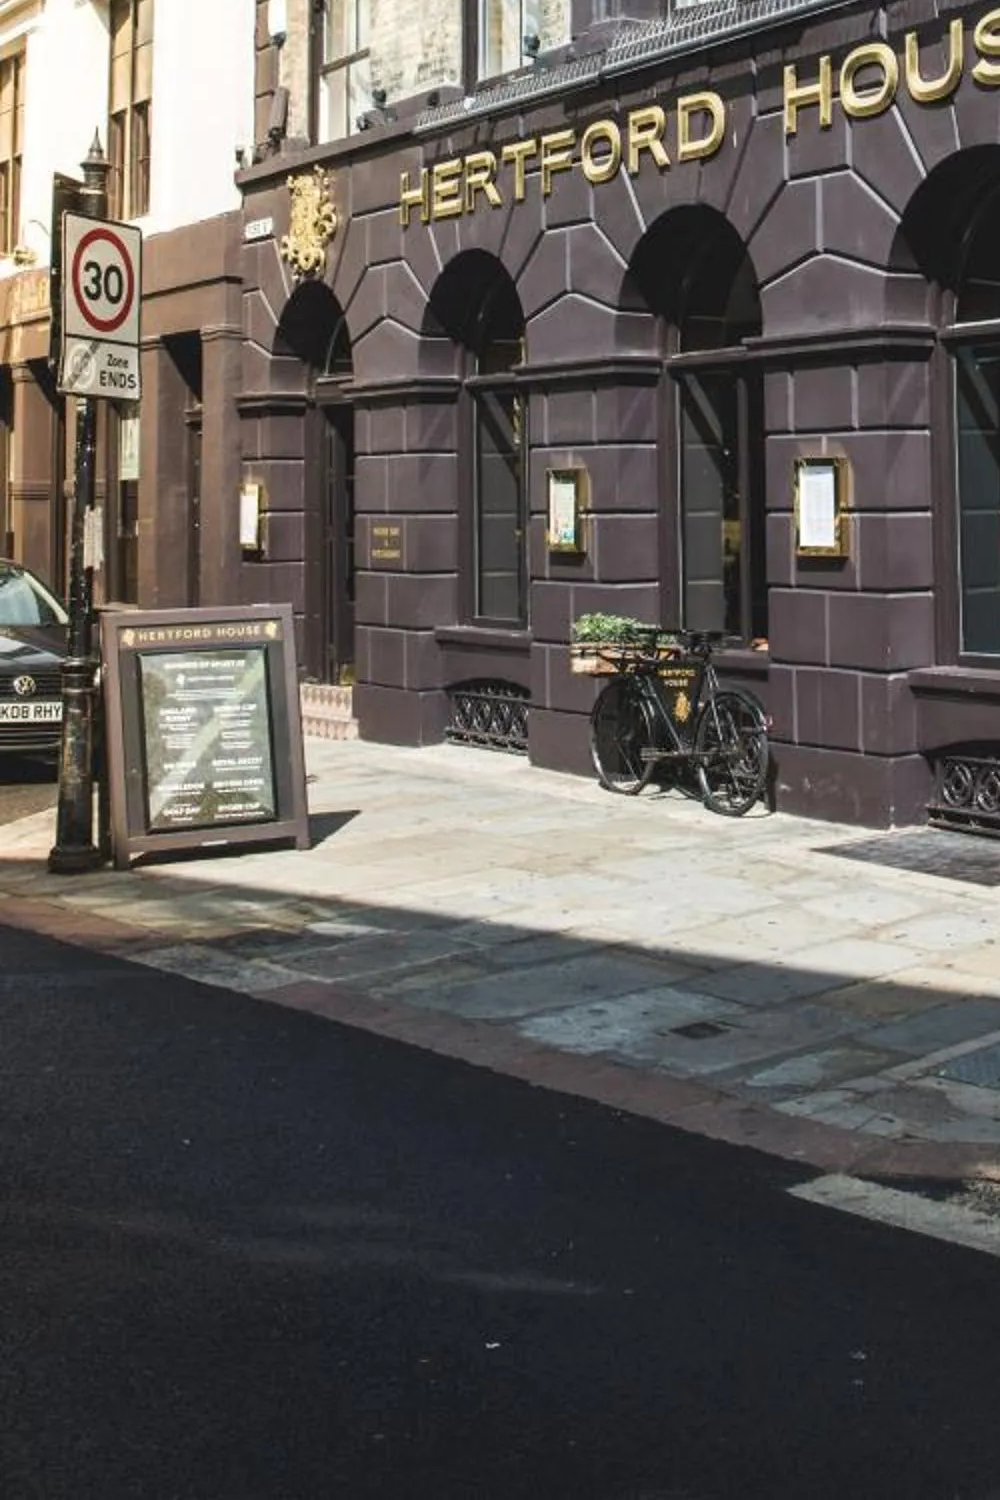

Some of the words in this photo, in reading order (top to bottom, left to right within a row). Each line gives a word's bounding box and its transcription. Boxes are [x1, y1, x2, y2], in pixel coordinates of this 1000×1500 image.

[401, 90, 726, 226] HERTFORD
[84, 260, 123, 304] 30
[107, 353, 129, 369] Zone
[100, 370, 137, 389] ENDS
[138, 626, 213, 643] HERTFORD
[216, 624, 262, 639] HOUSE
[33, 705, 61, 719] RHY
